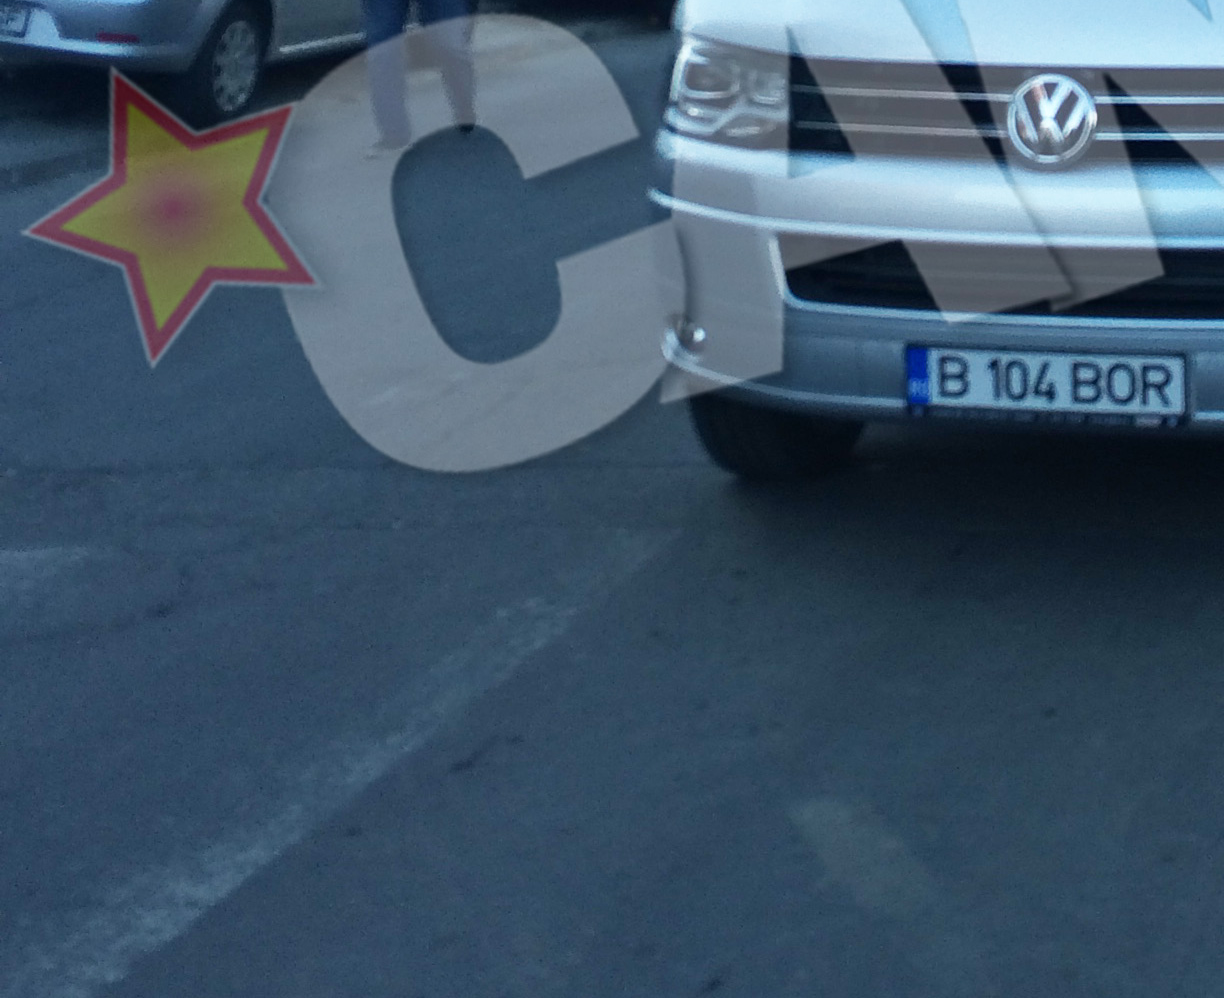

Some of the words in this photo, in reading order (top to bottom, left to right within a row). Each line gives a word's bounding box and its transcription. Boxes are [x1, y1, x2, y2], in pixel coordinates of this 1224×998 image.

[939, 355, 970, 399] B
[986, 358, 1058, 403] 104
[1071, 361, 1174, 407] BOR
